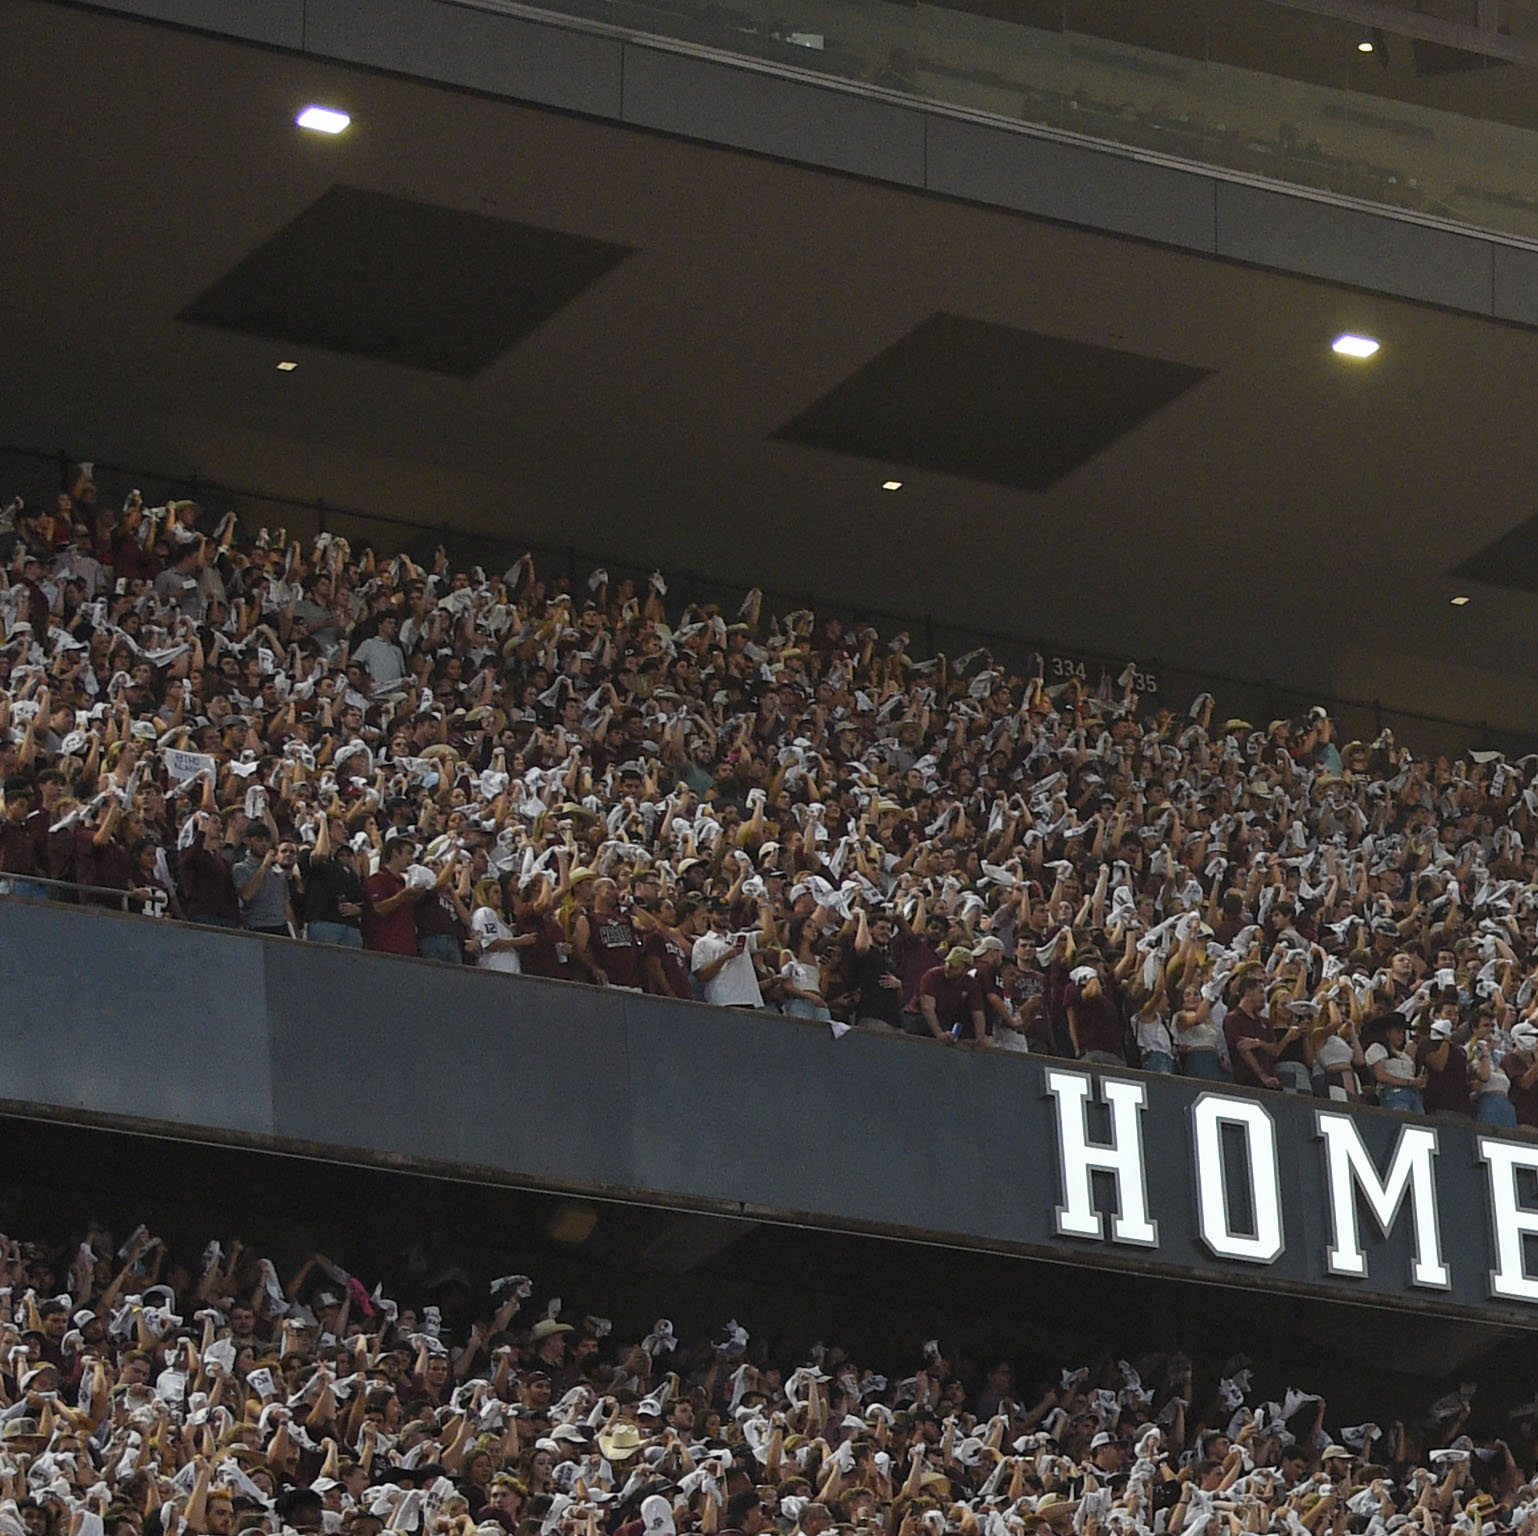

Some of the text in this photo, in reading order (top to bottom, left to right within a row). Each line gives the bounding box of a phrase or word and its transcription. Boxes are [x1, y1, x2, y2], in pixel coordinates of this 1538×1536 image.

[1051, 657, 1085, 680] 334
[1131, 670, 1158, 693] 35
[484, 922, 497, 936] 12
